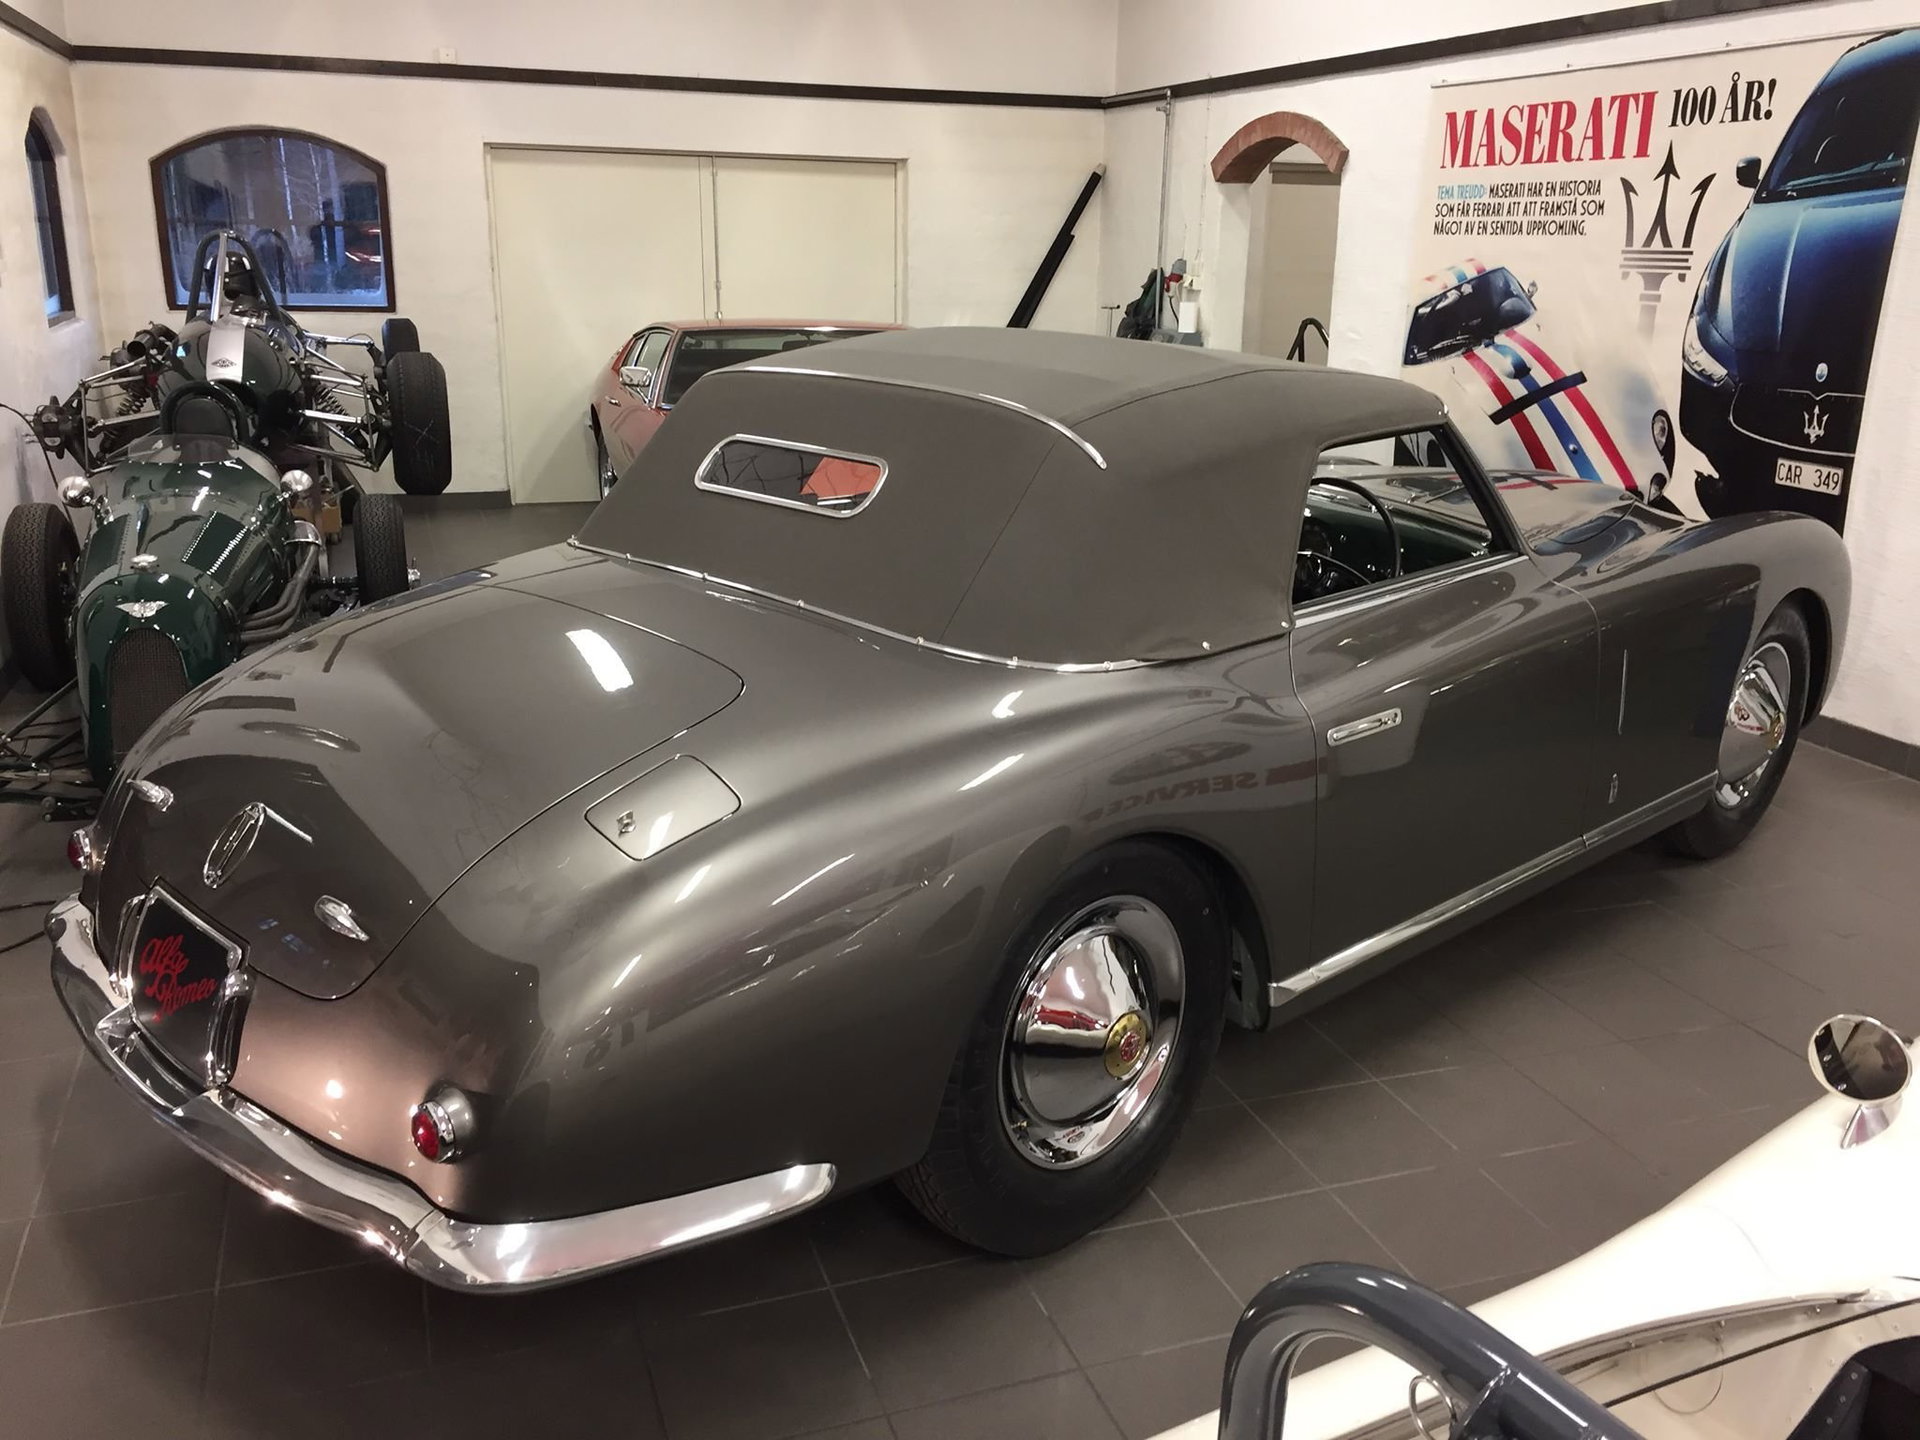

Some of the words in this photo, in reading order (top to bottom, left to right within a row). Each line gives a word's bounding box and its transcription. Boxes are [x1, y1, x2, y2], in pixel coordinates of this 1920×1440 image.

[1440, 91, 1659, 168] MASERATI
[1668, 86, 1717, 127] 100
[1719, 71, 1777, 123] ÅR!
[1437, 185, 1455, 200] TEMA
[1489, 182, 1526, 198] MASERATI
[1527, 181, 1544, 198] HAR
[1545, 181, 1557, 197] EN
[1559, 179, 1601, 196] HISTORIA
[1435, 203, 1455, 218] SOM
[1456, 200, 1471, 217] FÅR
[1472, 202, 1505, 218] FERRARI
[1506, 201, 1521, 217] ATT
[1522, 201, 1538, 217] ATT
[1539, 197, 1577, 216] FRAMSTÅ
[1580, 199, 1605, 216] SOM
[1433, 218, 1462, 235] NÅGOT
[1464, 220, 1476, 235] AV
[1477, 220, 1488, 235] EN
[1490, 220, 1523, 236] SENTIDA
[1526, 219, 1587, 236] UPPKOMLING.
[1777, 462, 1803, 485] CAR
[1813, 468, 1840, 492] 349
[139, 934, 190, 974] Alfa
